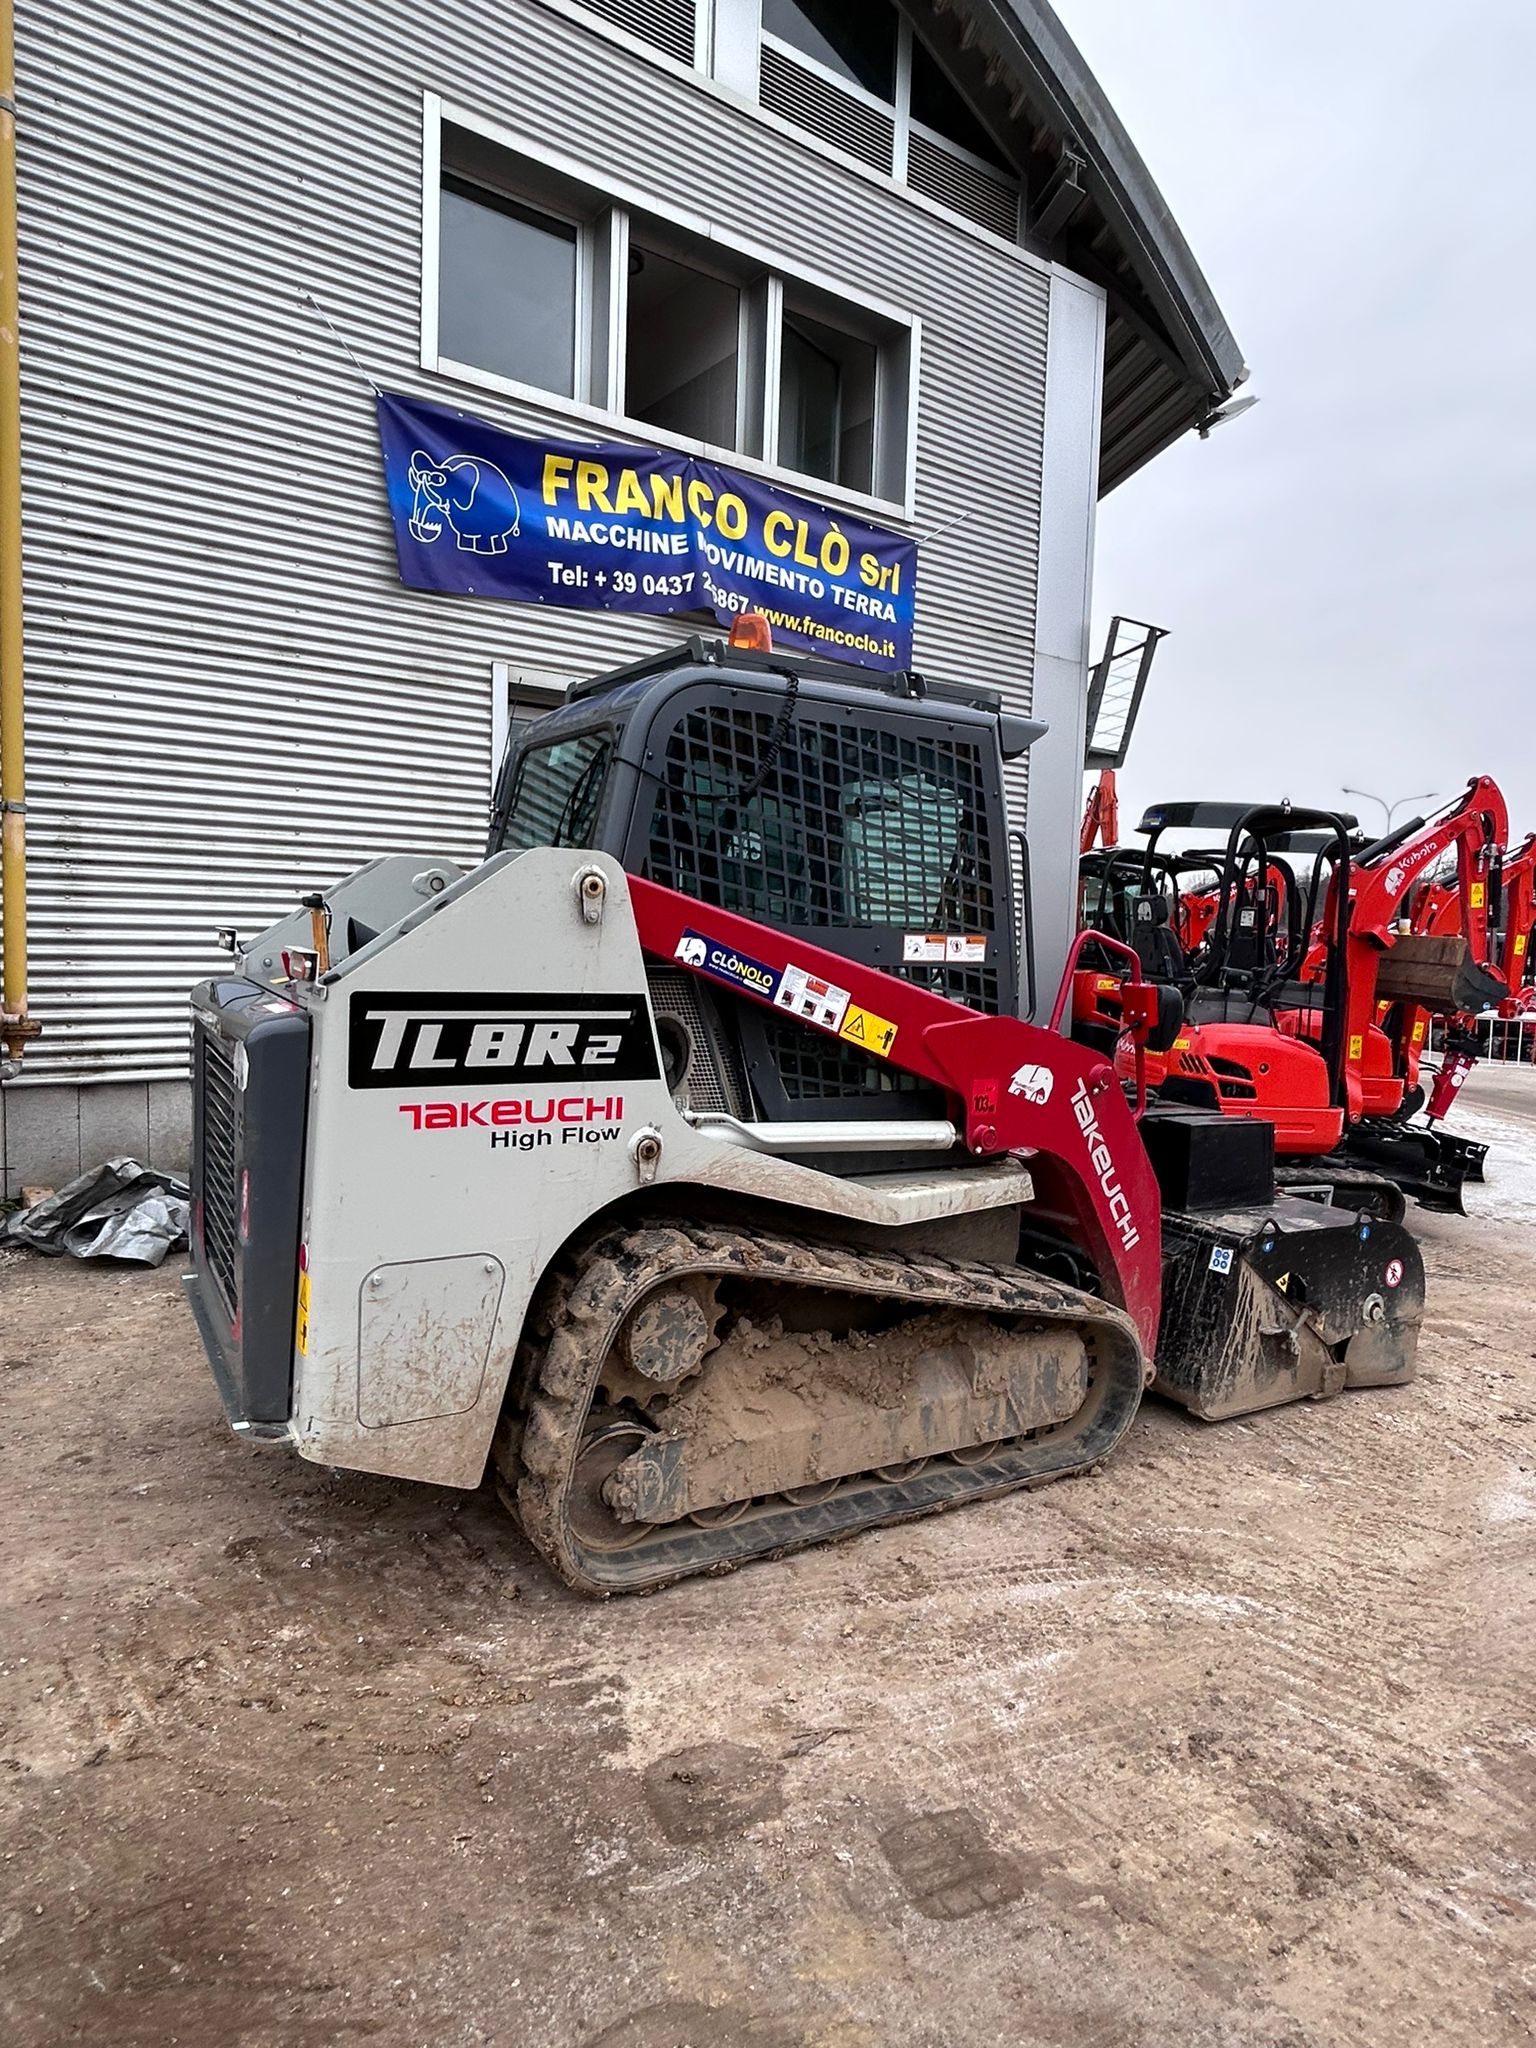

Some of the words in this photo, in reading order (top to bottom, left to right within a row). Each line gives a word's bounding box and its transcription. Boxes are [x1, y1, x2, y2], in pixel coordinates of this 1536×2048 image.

[543, 454, 748, 540] FRANCO
[763, 510, 850, 576] CLÒ
[859, 553, 901, 595] Srl
[545, 516, 689, 555] MACCHINE
[831, 584, 897, 623] TERRA
[547, 561, 589, 588] Tel:
[594, 571, 607, 587] +
[612, 570, 637, 593] 39
[643, 573, 695, 595] 0437
[754, 605, 896, 658] www.francoclo.it
[1398, 842, 1438, 869] Kubota
[711, 951, 774, 987] CLÒNOLO
[365, 1010, 632, 1070] TL8R2
[490, 1129, 551, 1151] High
[562, 1127, 620, 1145] Flow
